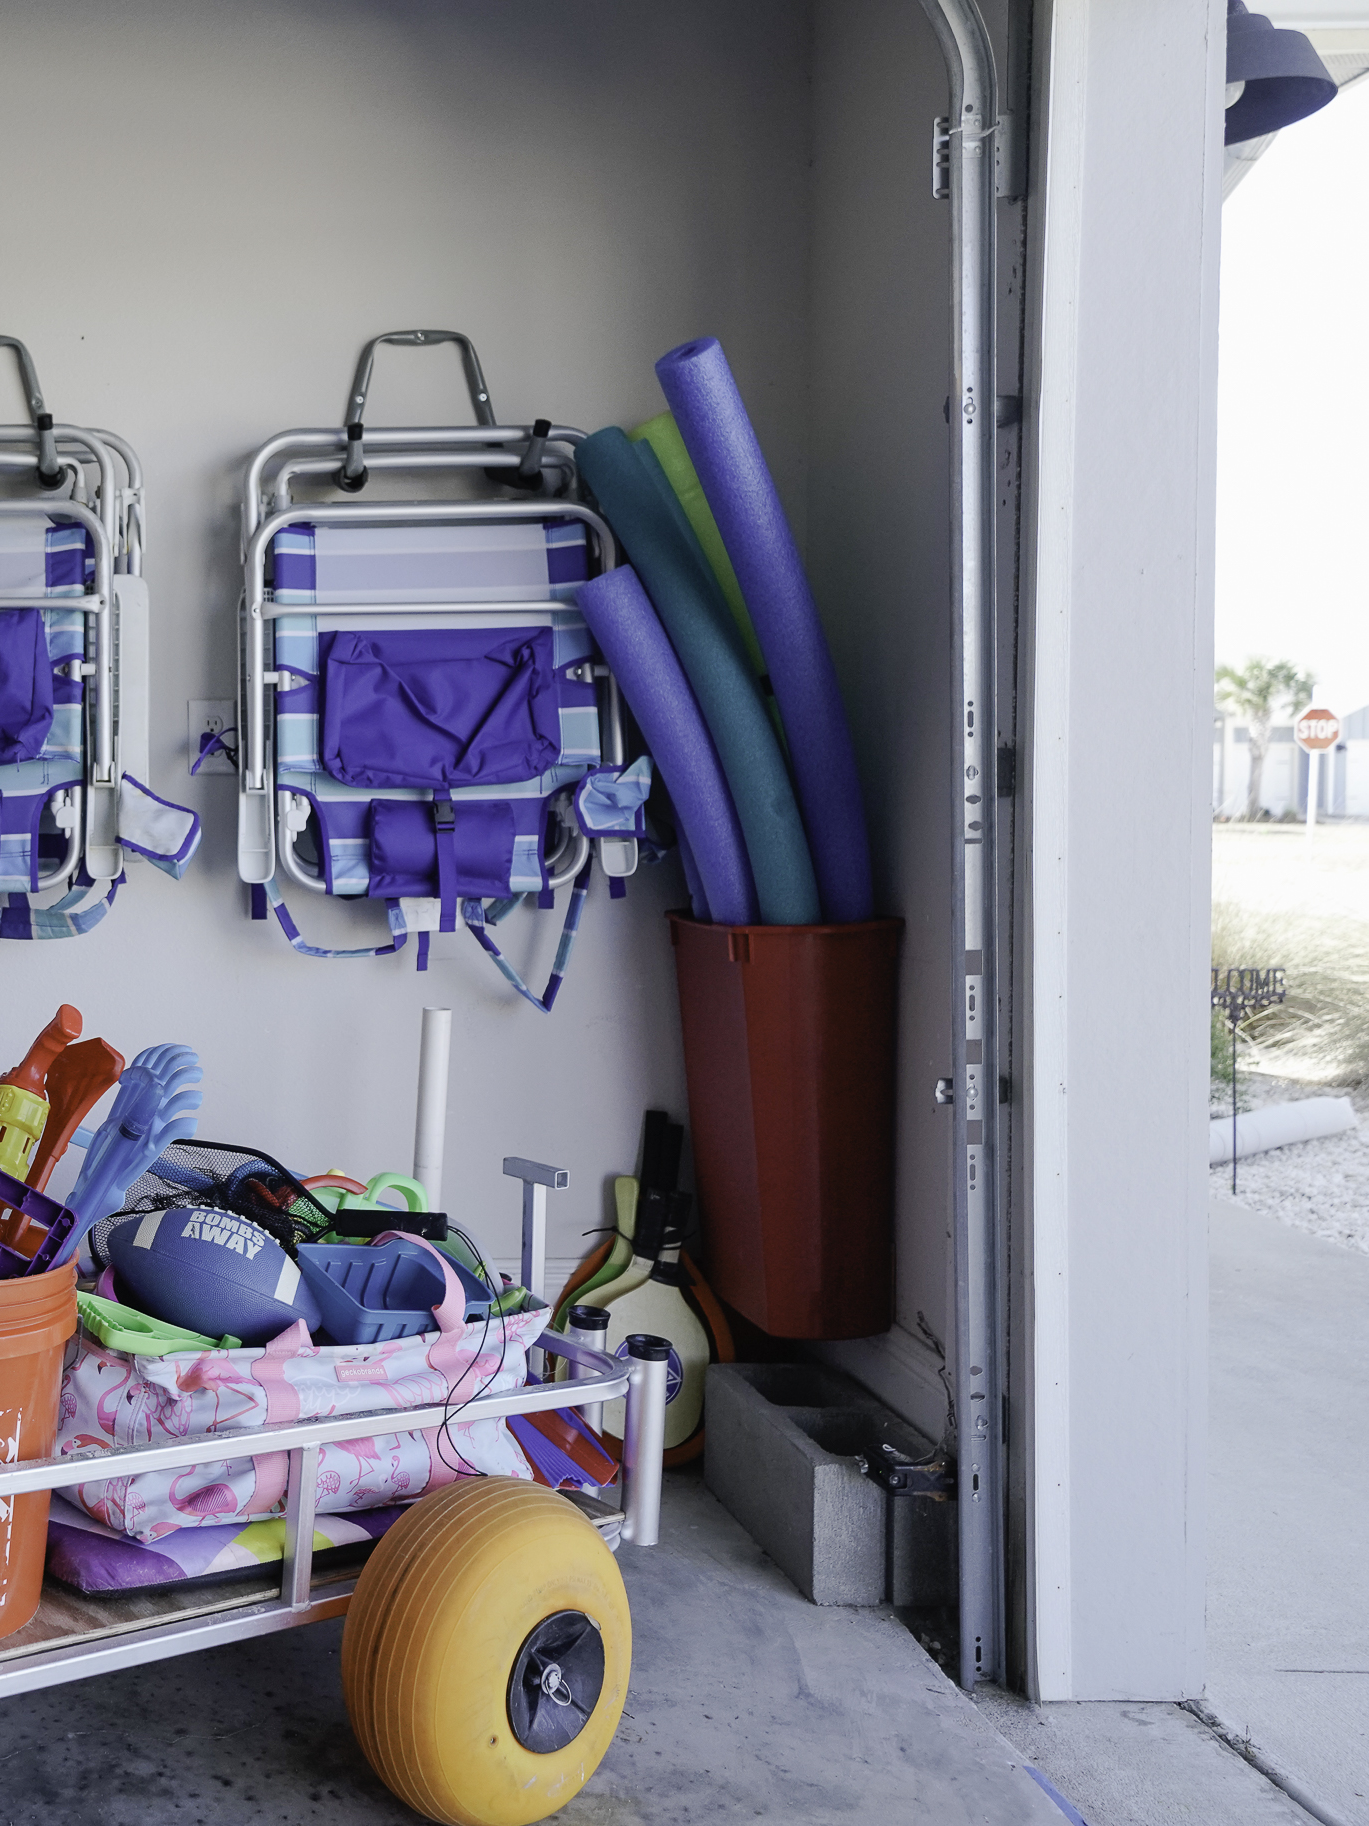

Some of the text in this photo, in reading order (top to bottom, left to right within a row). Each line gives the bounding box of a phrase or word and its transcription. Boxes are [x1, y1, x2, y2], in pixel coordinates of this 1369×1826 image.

[1298, 718, 1339, 739] STOP
[1211, 968, 1286, 997] LCOME
[181, 1221, 262, 1260] AWAY
[190, 1210, 266, 1247] BOMBS
[340, 1367, 384, 1377] geckobrands
